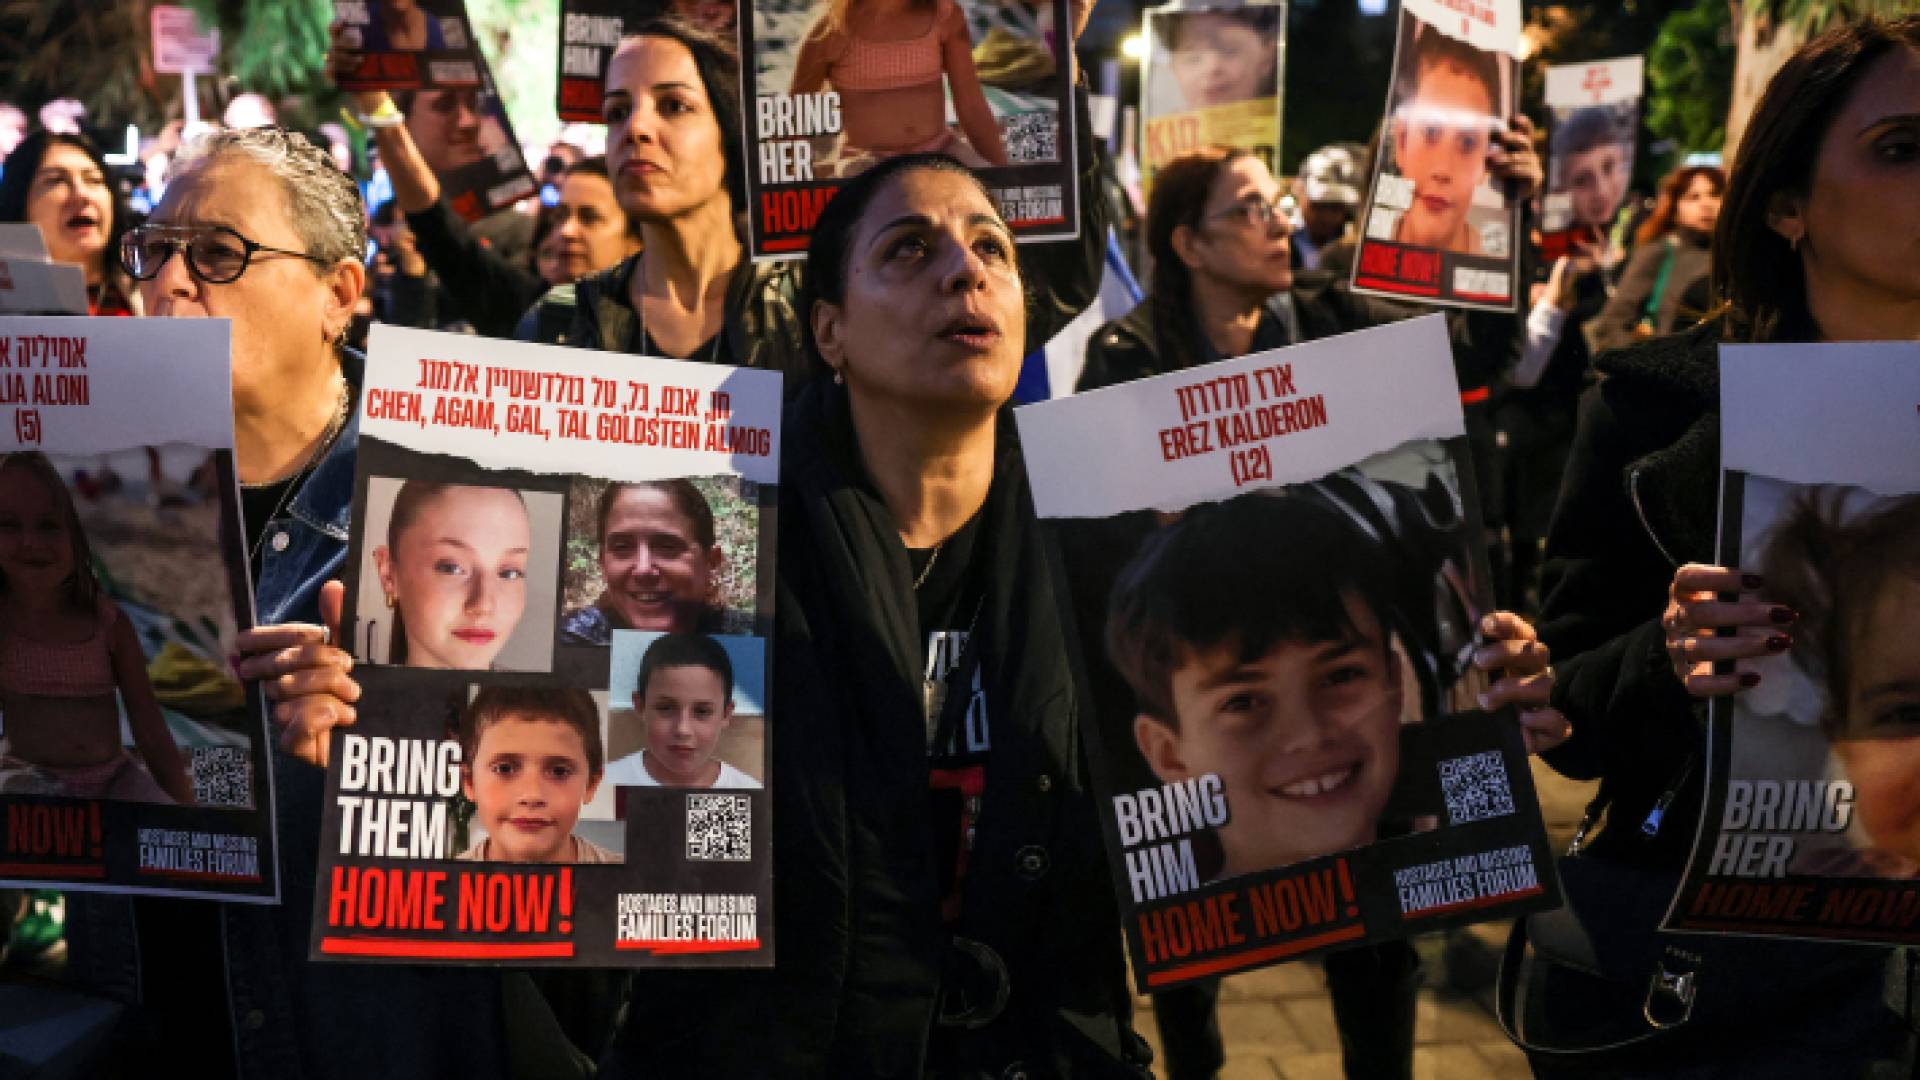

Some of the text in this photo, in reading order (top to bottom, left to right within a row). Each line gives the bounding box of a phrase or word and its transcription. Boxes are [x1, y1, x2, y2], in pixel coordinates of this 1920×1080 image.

[757, 90, 841, 139] BRING
[758, 140, 813, 184] HER
[760, 186, 840, 234] HOM
[15, 335, 88, 368] אמיליה
[32, 373, 89, 406] ALONI
[416, 359, 479, 395] אלמוג
[485, 366, 584, 405] גולדשטיין
[591, 375, 617, 408] טל
[1174, 362, 1297, 422] ארז קלדרון
[15, 407, 41, 445] (5)
[367, 388, 771, 456] CHEN, AGAM, GAL, TAL GOLDSTEIN ALMOG
[1158, 393, 1328, 462] EREZ KALDERON
[1231, 444, 1273, 487] (12)
[338, 733, 464, 798] BRING
[8, 800, 104, 858] NOW!
[336, 795, 448, 860] THEM
[1112, 773, 1228, 847] BRING
[1722, 779, 1854, 831] BRING
[139, 844, 259, 877] FAMILIES FORUM
[1125, 838, 1200, 903] HIM
[1706, 833, 1794, 879] HER
[328, 865, 574, 934] HOME NOW!
[1138, 857, 1360, 966] HOME NOW!
[1399, 863, 1538, 913] FAMILIES FORUM
[1690, 881, 1816, 922] HOME
[618, 914, 757, 943] FAMILIES FORUM
